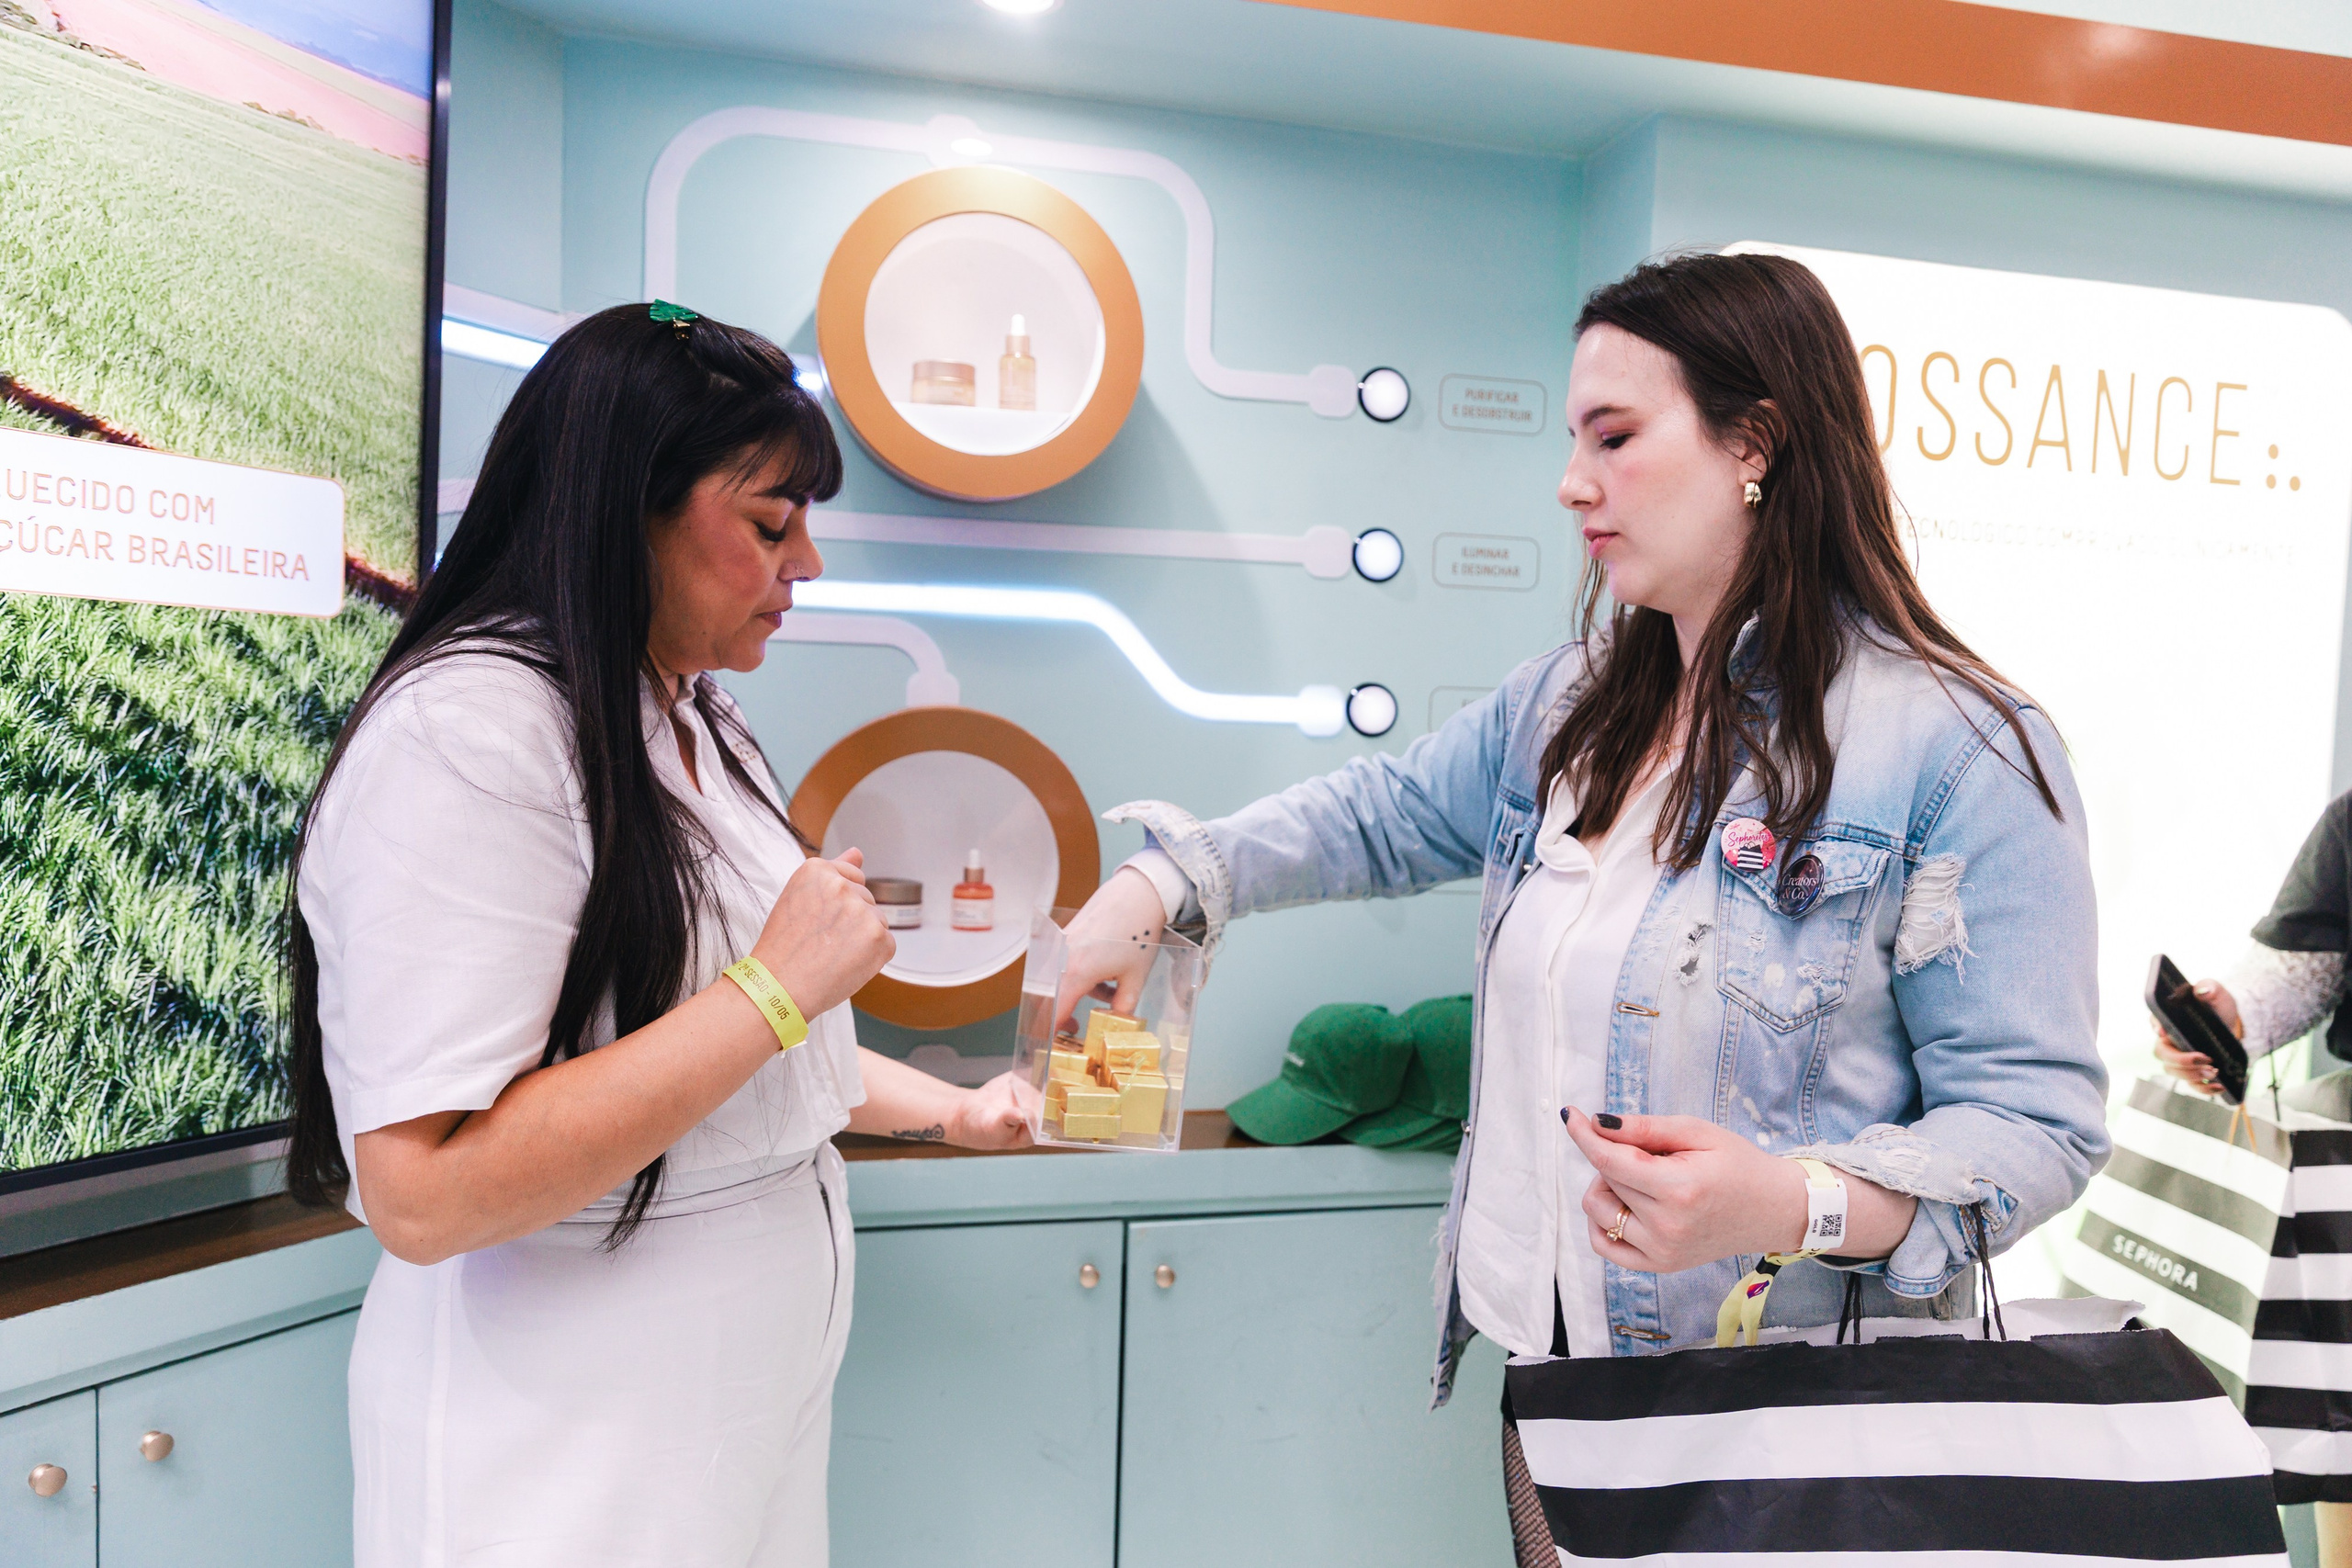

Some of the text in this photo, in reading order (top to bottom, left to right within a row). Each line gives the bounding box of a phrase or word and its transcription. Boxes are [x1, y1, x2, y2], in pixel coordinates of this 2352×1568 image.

[149, 490, 215, 525] COM
[129, 534, 311, 581] BRASILEIRA
[1782, 874, 1817, 886] Creators
[1782, 886, 1805, 899] & Co.
[744, 967, 769, 993] SESSÃO
[768, 995, 790, 1021] 10/05
[2112, 1235, 2199, 1292] SEPHORA
